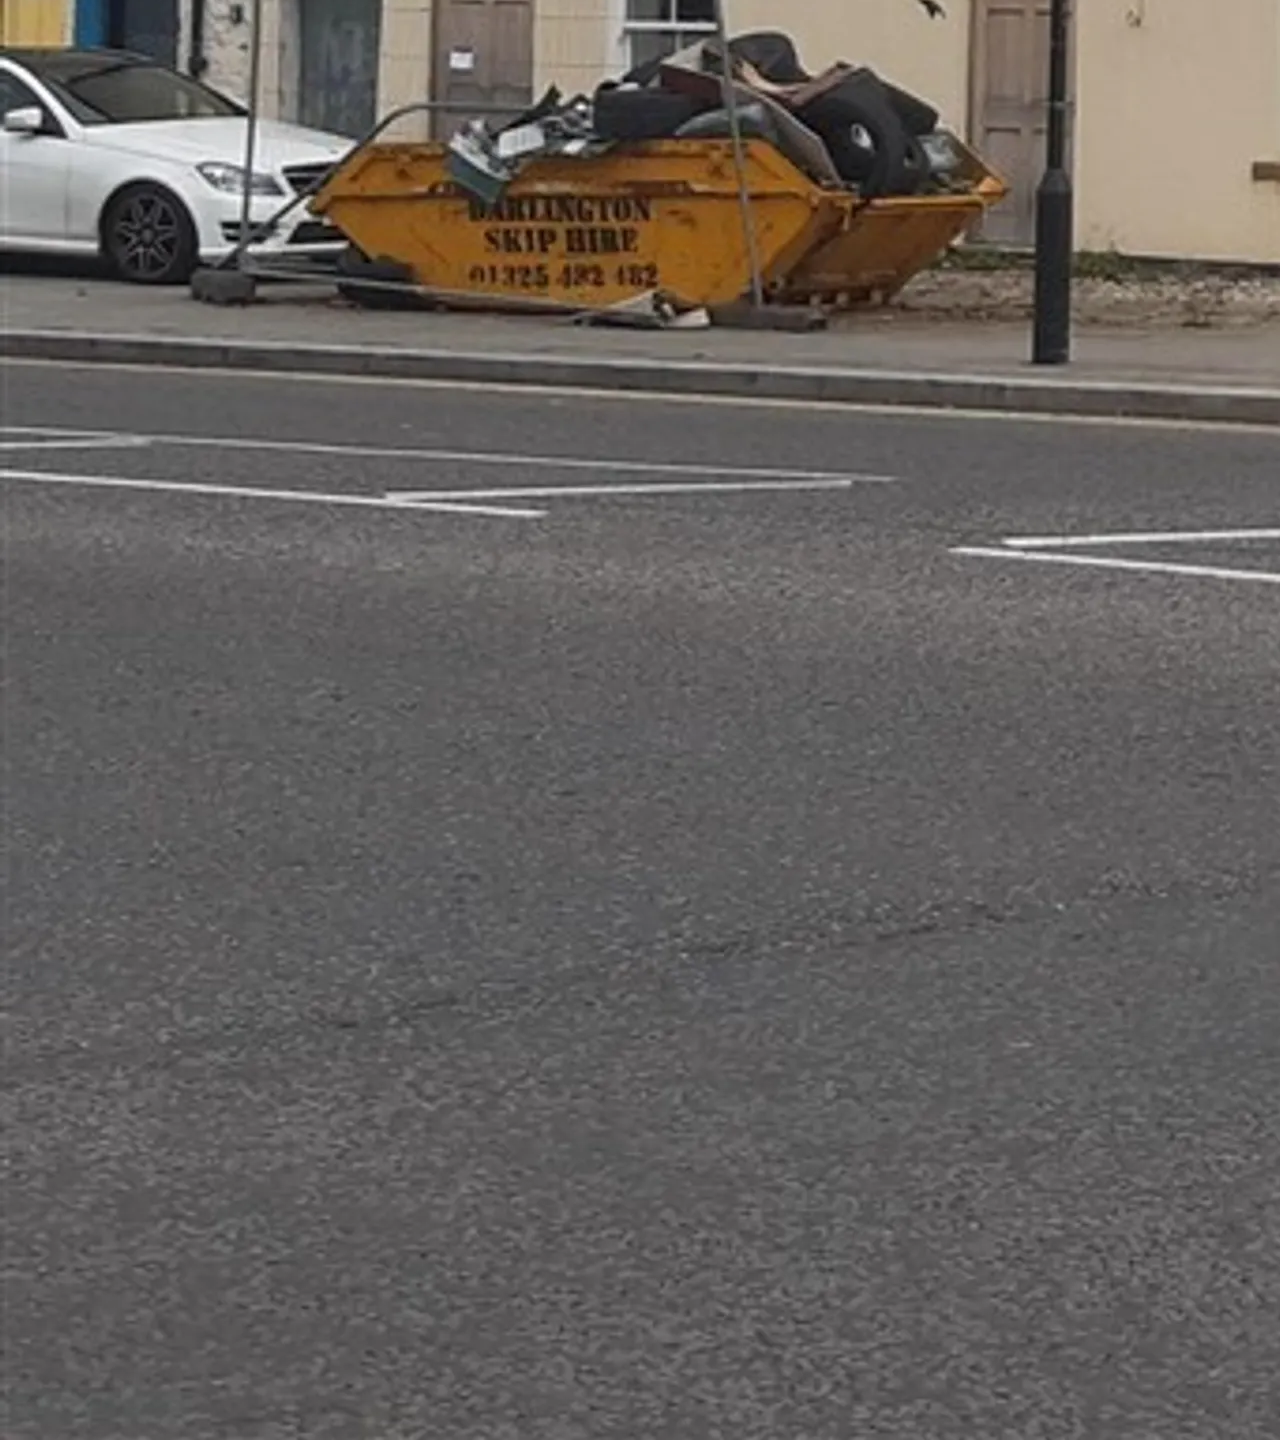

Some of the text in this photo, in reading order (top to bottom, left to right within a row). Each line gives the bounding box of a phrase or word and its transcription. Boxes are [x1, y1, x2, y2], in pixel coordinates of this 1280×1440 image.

[468, 196, 651, 222] DARLINGTON
[484, 227, 638, 252] SKIP HIRE
[468, 264, 549, 287] 01325
